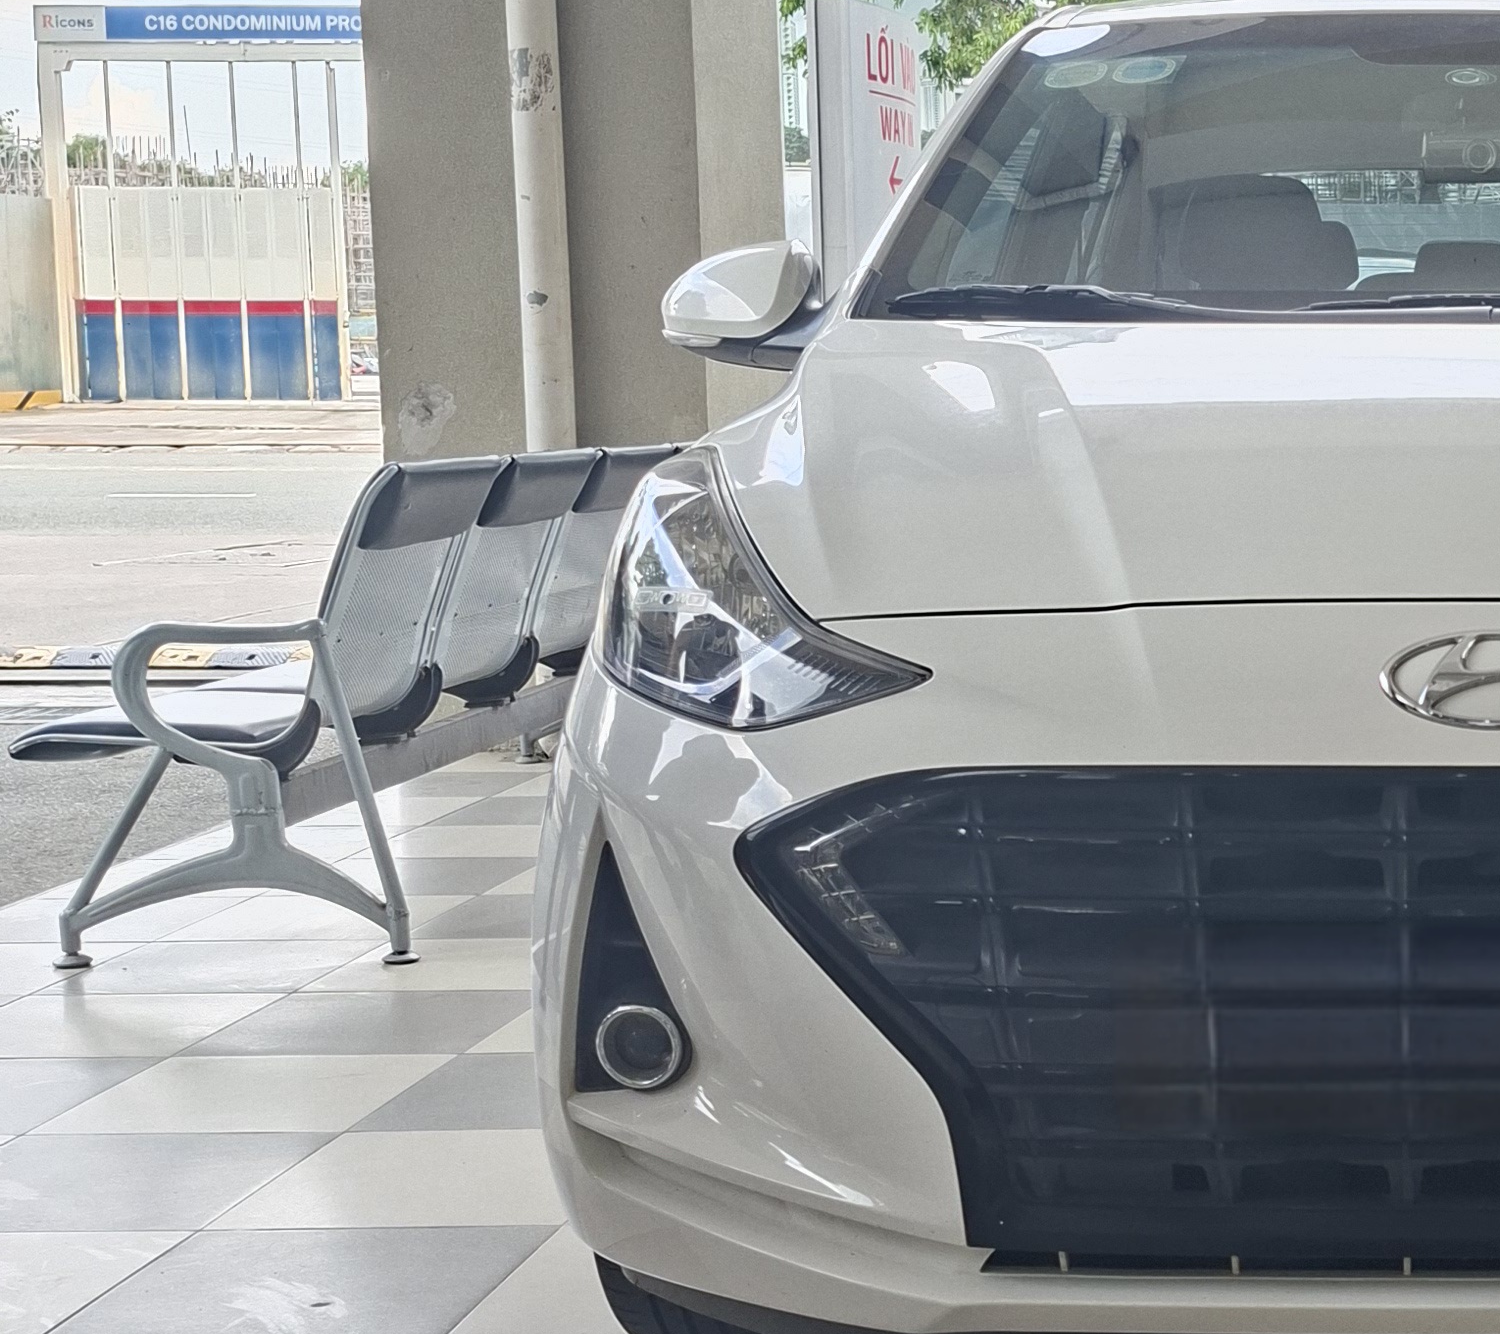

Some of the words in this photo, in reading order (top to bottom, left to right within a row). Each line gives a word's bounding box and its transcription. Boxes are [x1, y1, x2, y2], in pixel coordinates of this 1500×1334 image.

[144, 14, 178, 31] C16
[181, 14, 322, 31] CONDOMINIUM
[865, 25, 895, 85] LỐI
[879, 105, 906, 145] WAY
